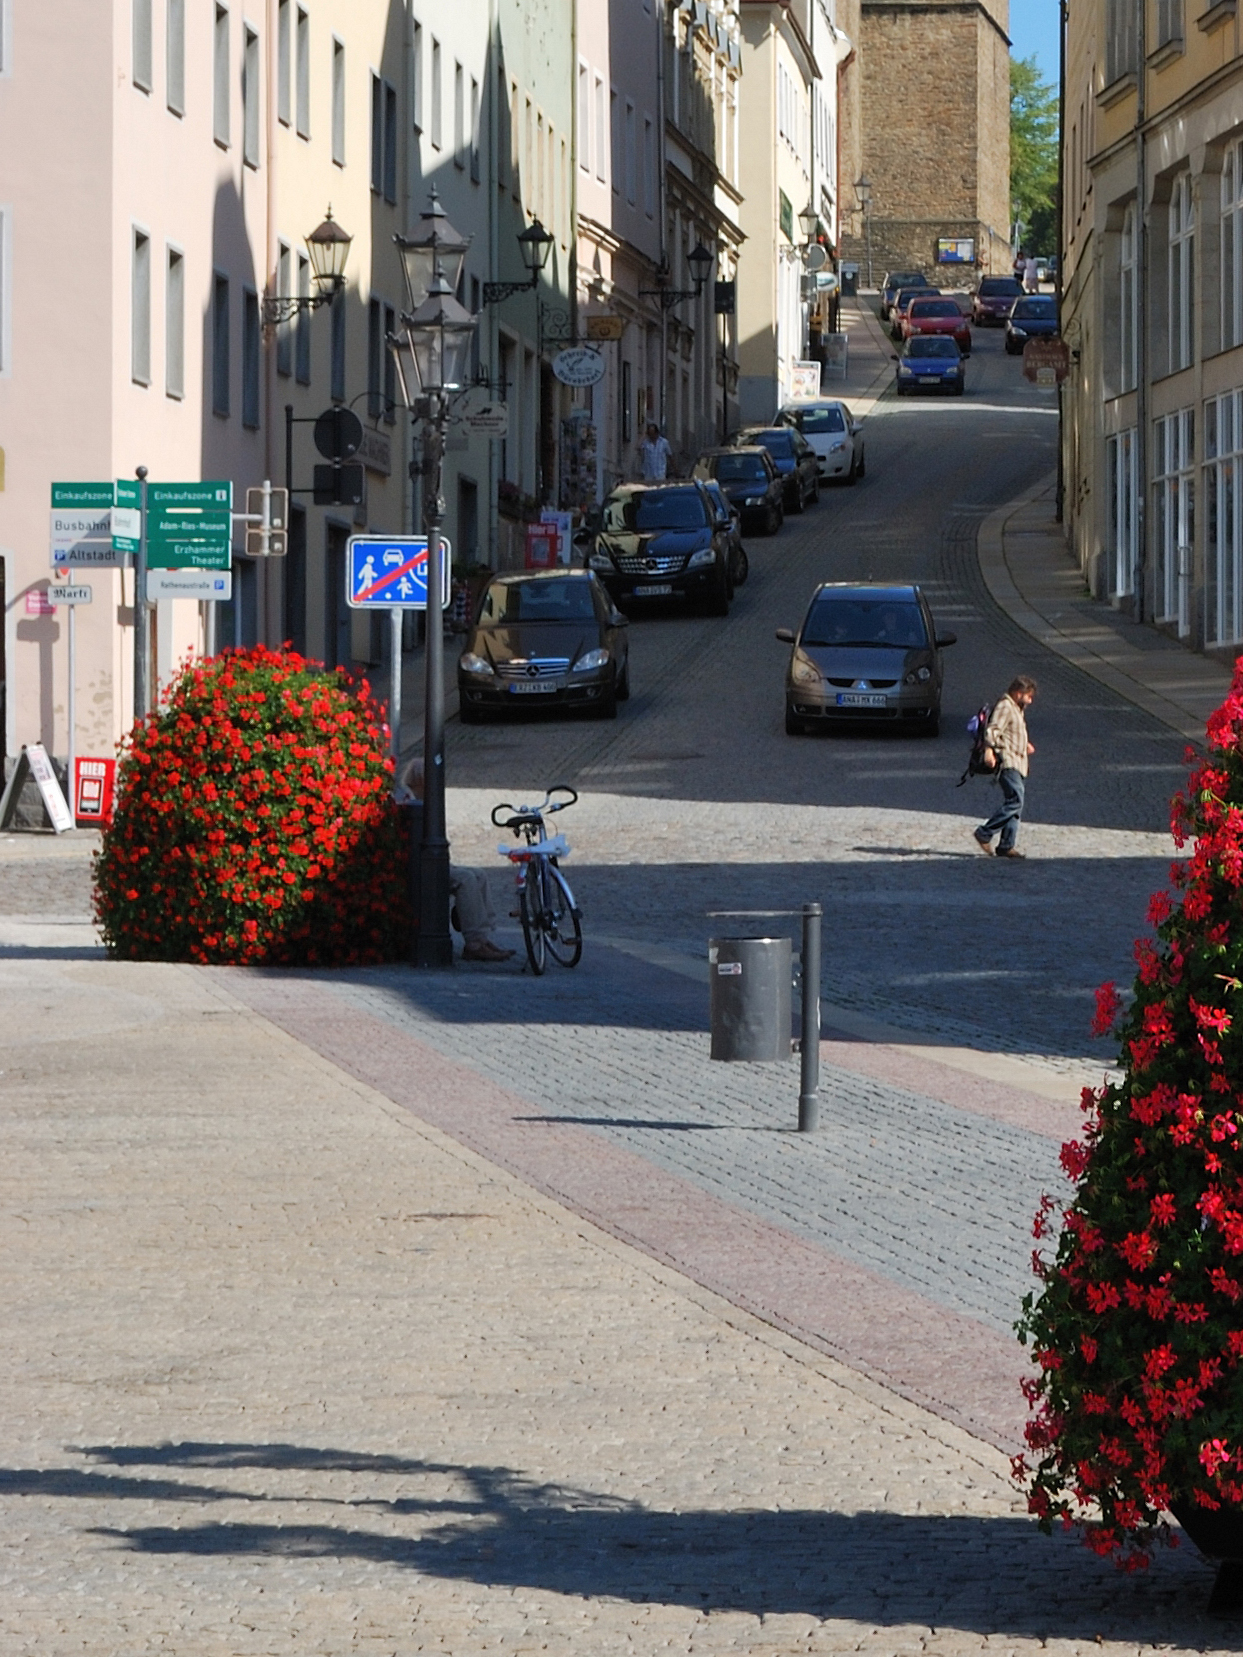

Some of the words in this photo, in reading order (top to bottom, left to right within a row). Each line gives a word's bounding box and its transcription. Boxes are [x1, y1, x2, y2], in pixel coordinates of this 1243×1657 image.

[55, 492, 112, 501] Einkaufszone
[154, 492, 212, 501] Einkaufszone
[159, 522, 226, 531] Adam-Ries-Museum
[174, 545, 225, 554] Erzhammer
[69, 549, 116, 561] Altstadt
[191, 555, 225, 565] Theater
[80, 761, 106, 777] HIER
